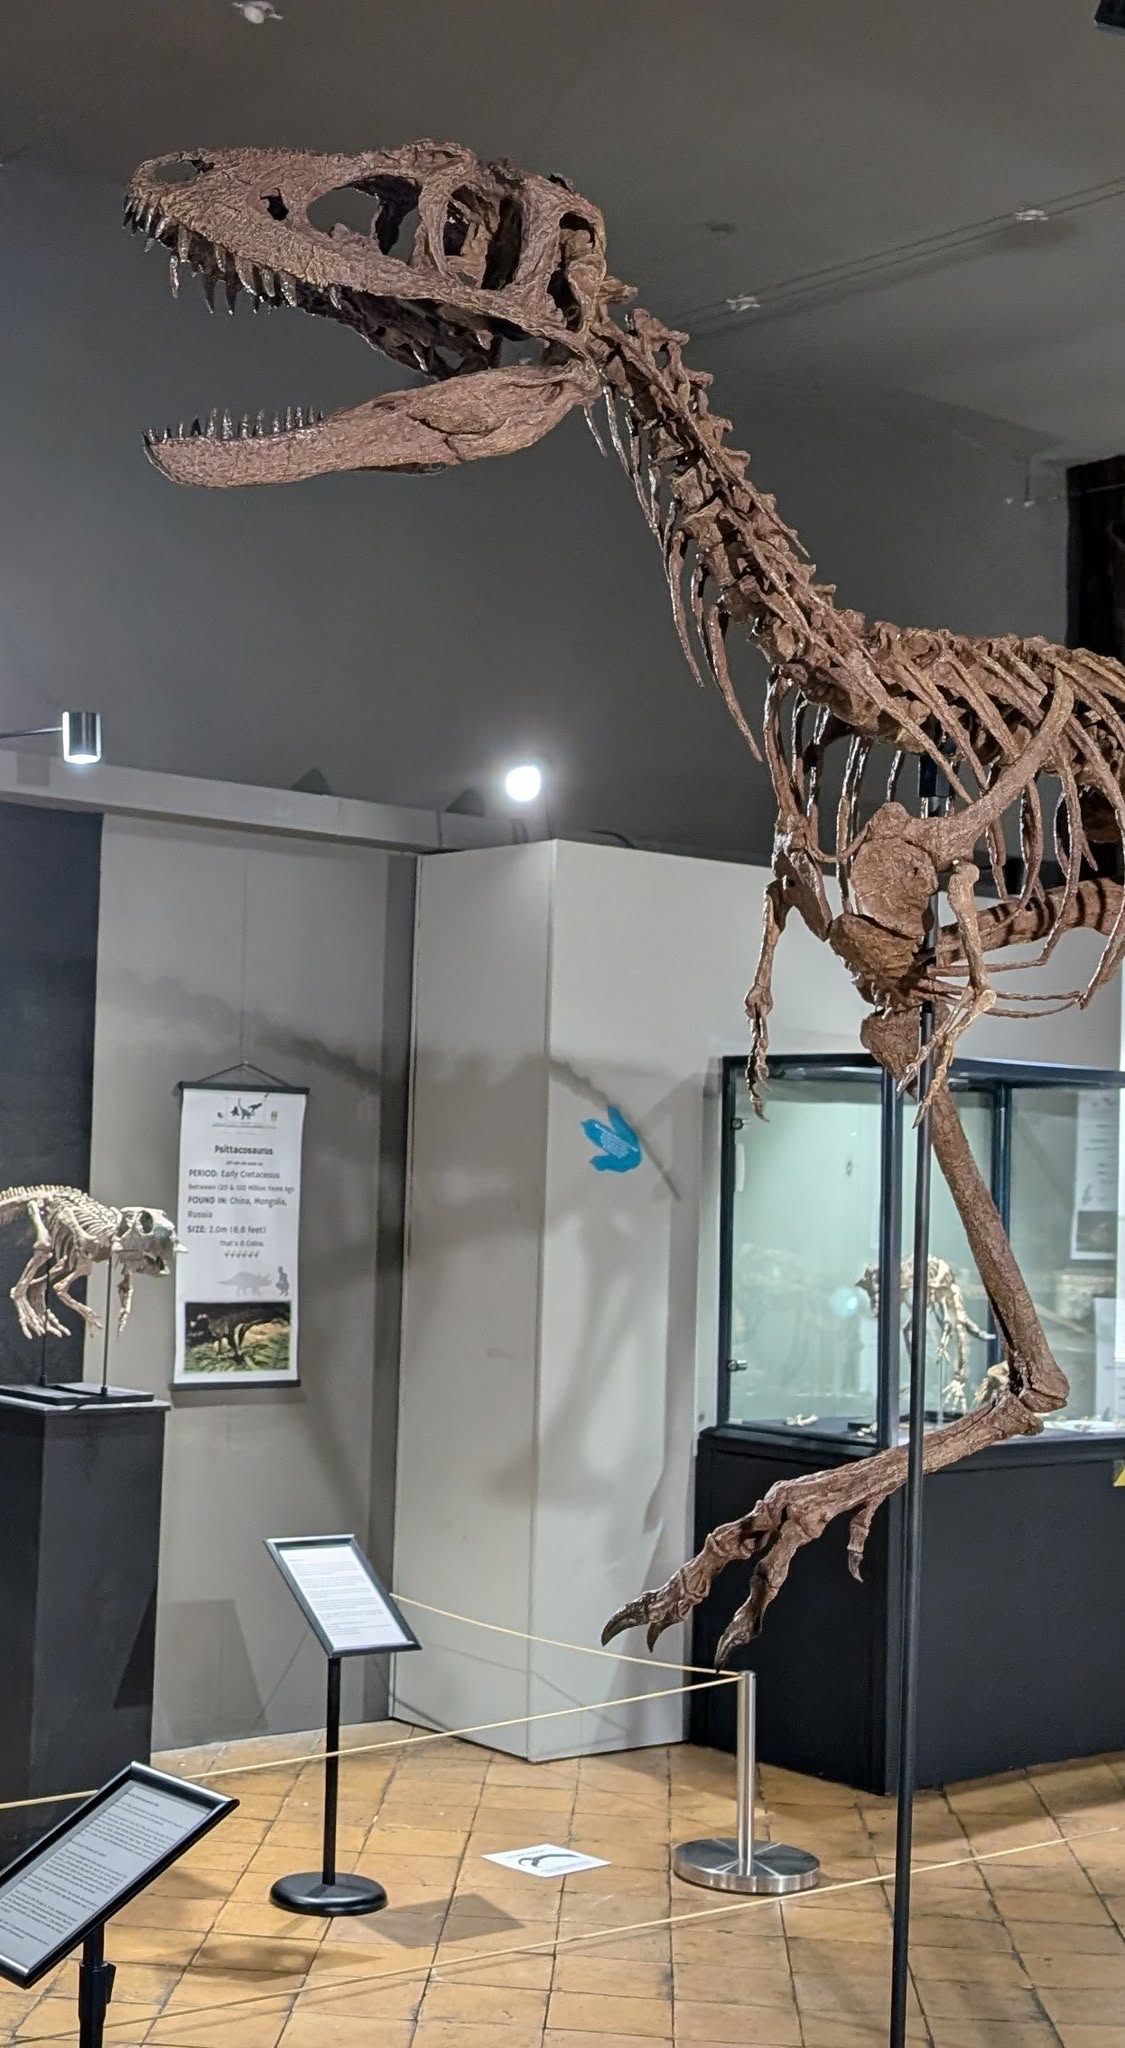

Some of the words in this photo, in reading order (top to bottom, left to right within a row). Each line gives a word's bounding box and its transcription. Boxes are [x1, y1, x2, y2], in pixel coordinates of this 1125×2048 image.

[215, 1145, 273, 1155] Psittacosaurus
[188, 1169, 218, 1178] PERIOD:
[221, 1170, 239, 1179] Early
[240, 1170, 280, 1179] Cretaceous
[187, 1196, 215, 1204] FOUND
[229, 1197, 252, 1205] China,
[254, 1198, 288, 1208] Mongolia,
[187, 1210, 213, 1218] Russia
[187, 1225, 206, 1233] SIZE:
[247, 1225, 267, 1234] feet)
